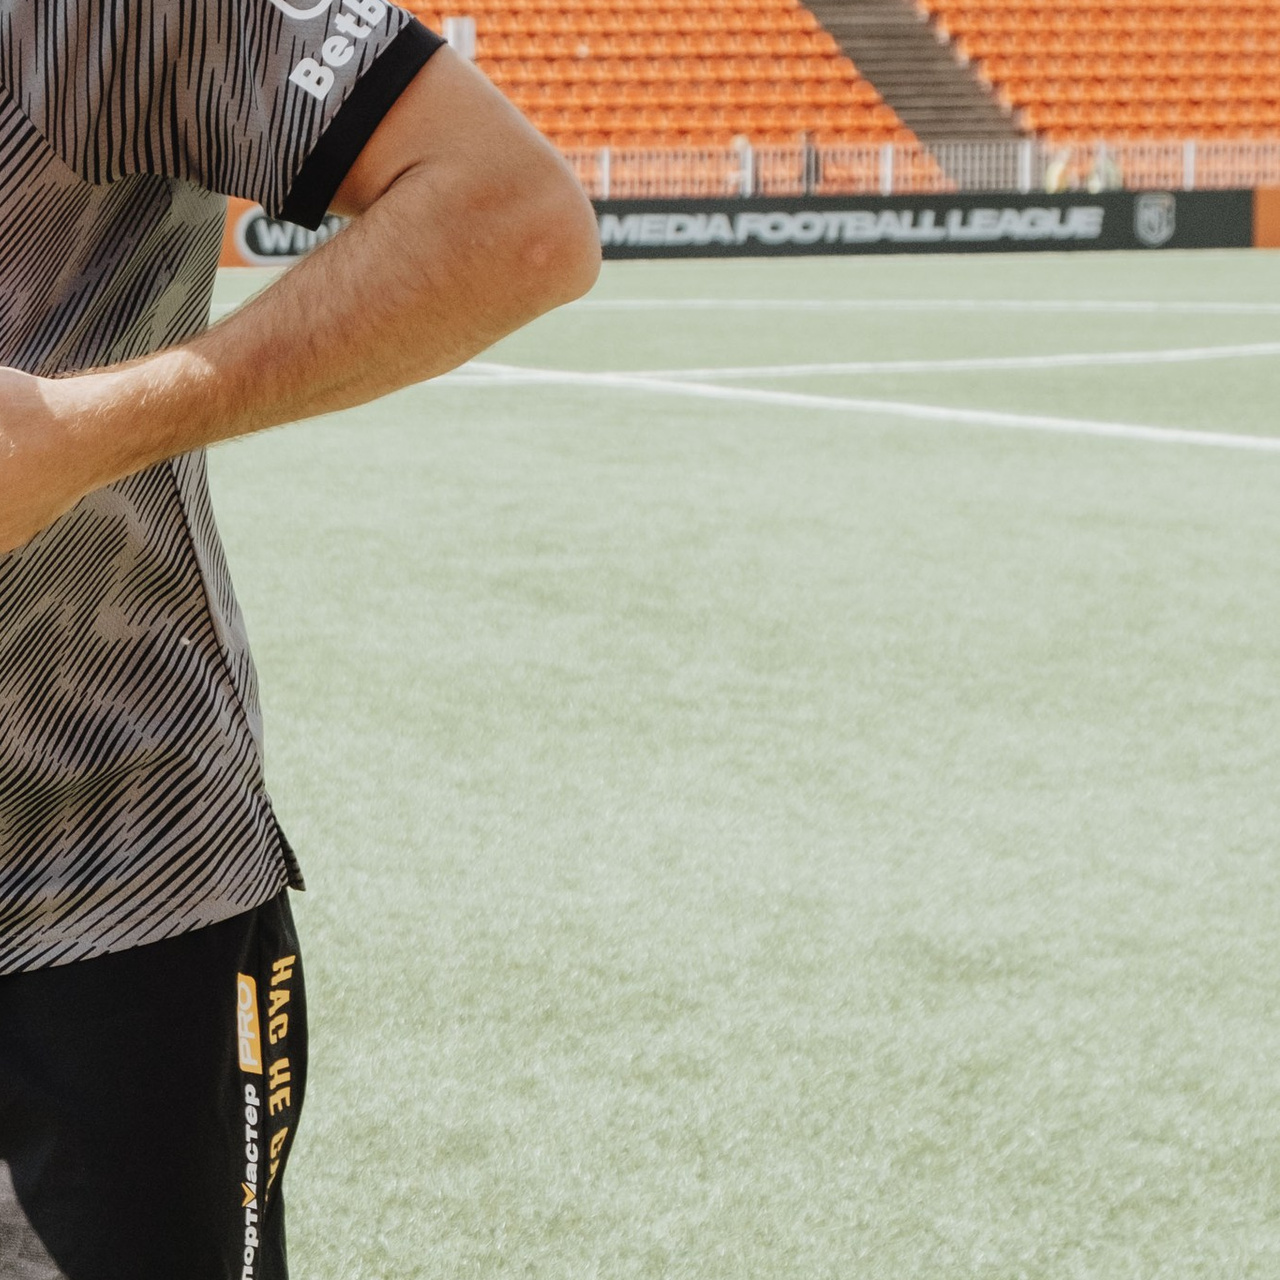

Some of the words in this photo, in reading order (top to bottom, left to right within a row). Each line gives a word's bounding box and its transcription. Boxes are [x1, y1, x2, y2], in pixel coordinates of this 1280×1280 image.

[599, 213, 735, 246] MEDIA
[734, 211, 948, 245] FOOTBALL
[944, 206, 1106, 241] LEAGUE
[238, 980, 259, 1066] PRO
[268, 954, 297, 1046] НАС
[269, 1057, 292, 1117] НЕ
